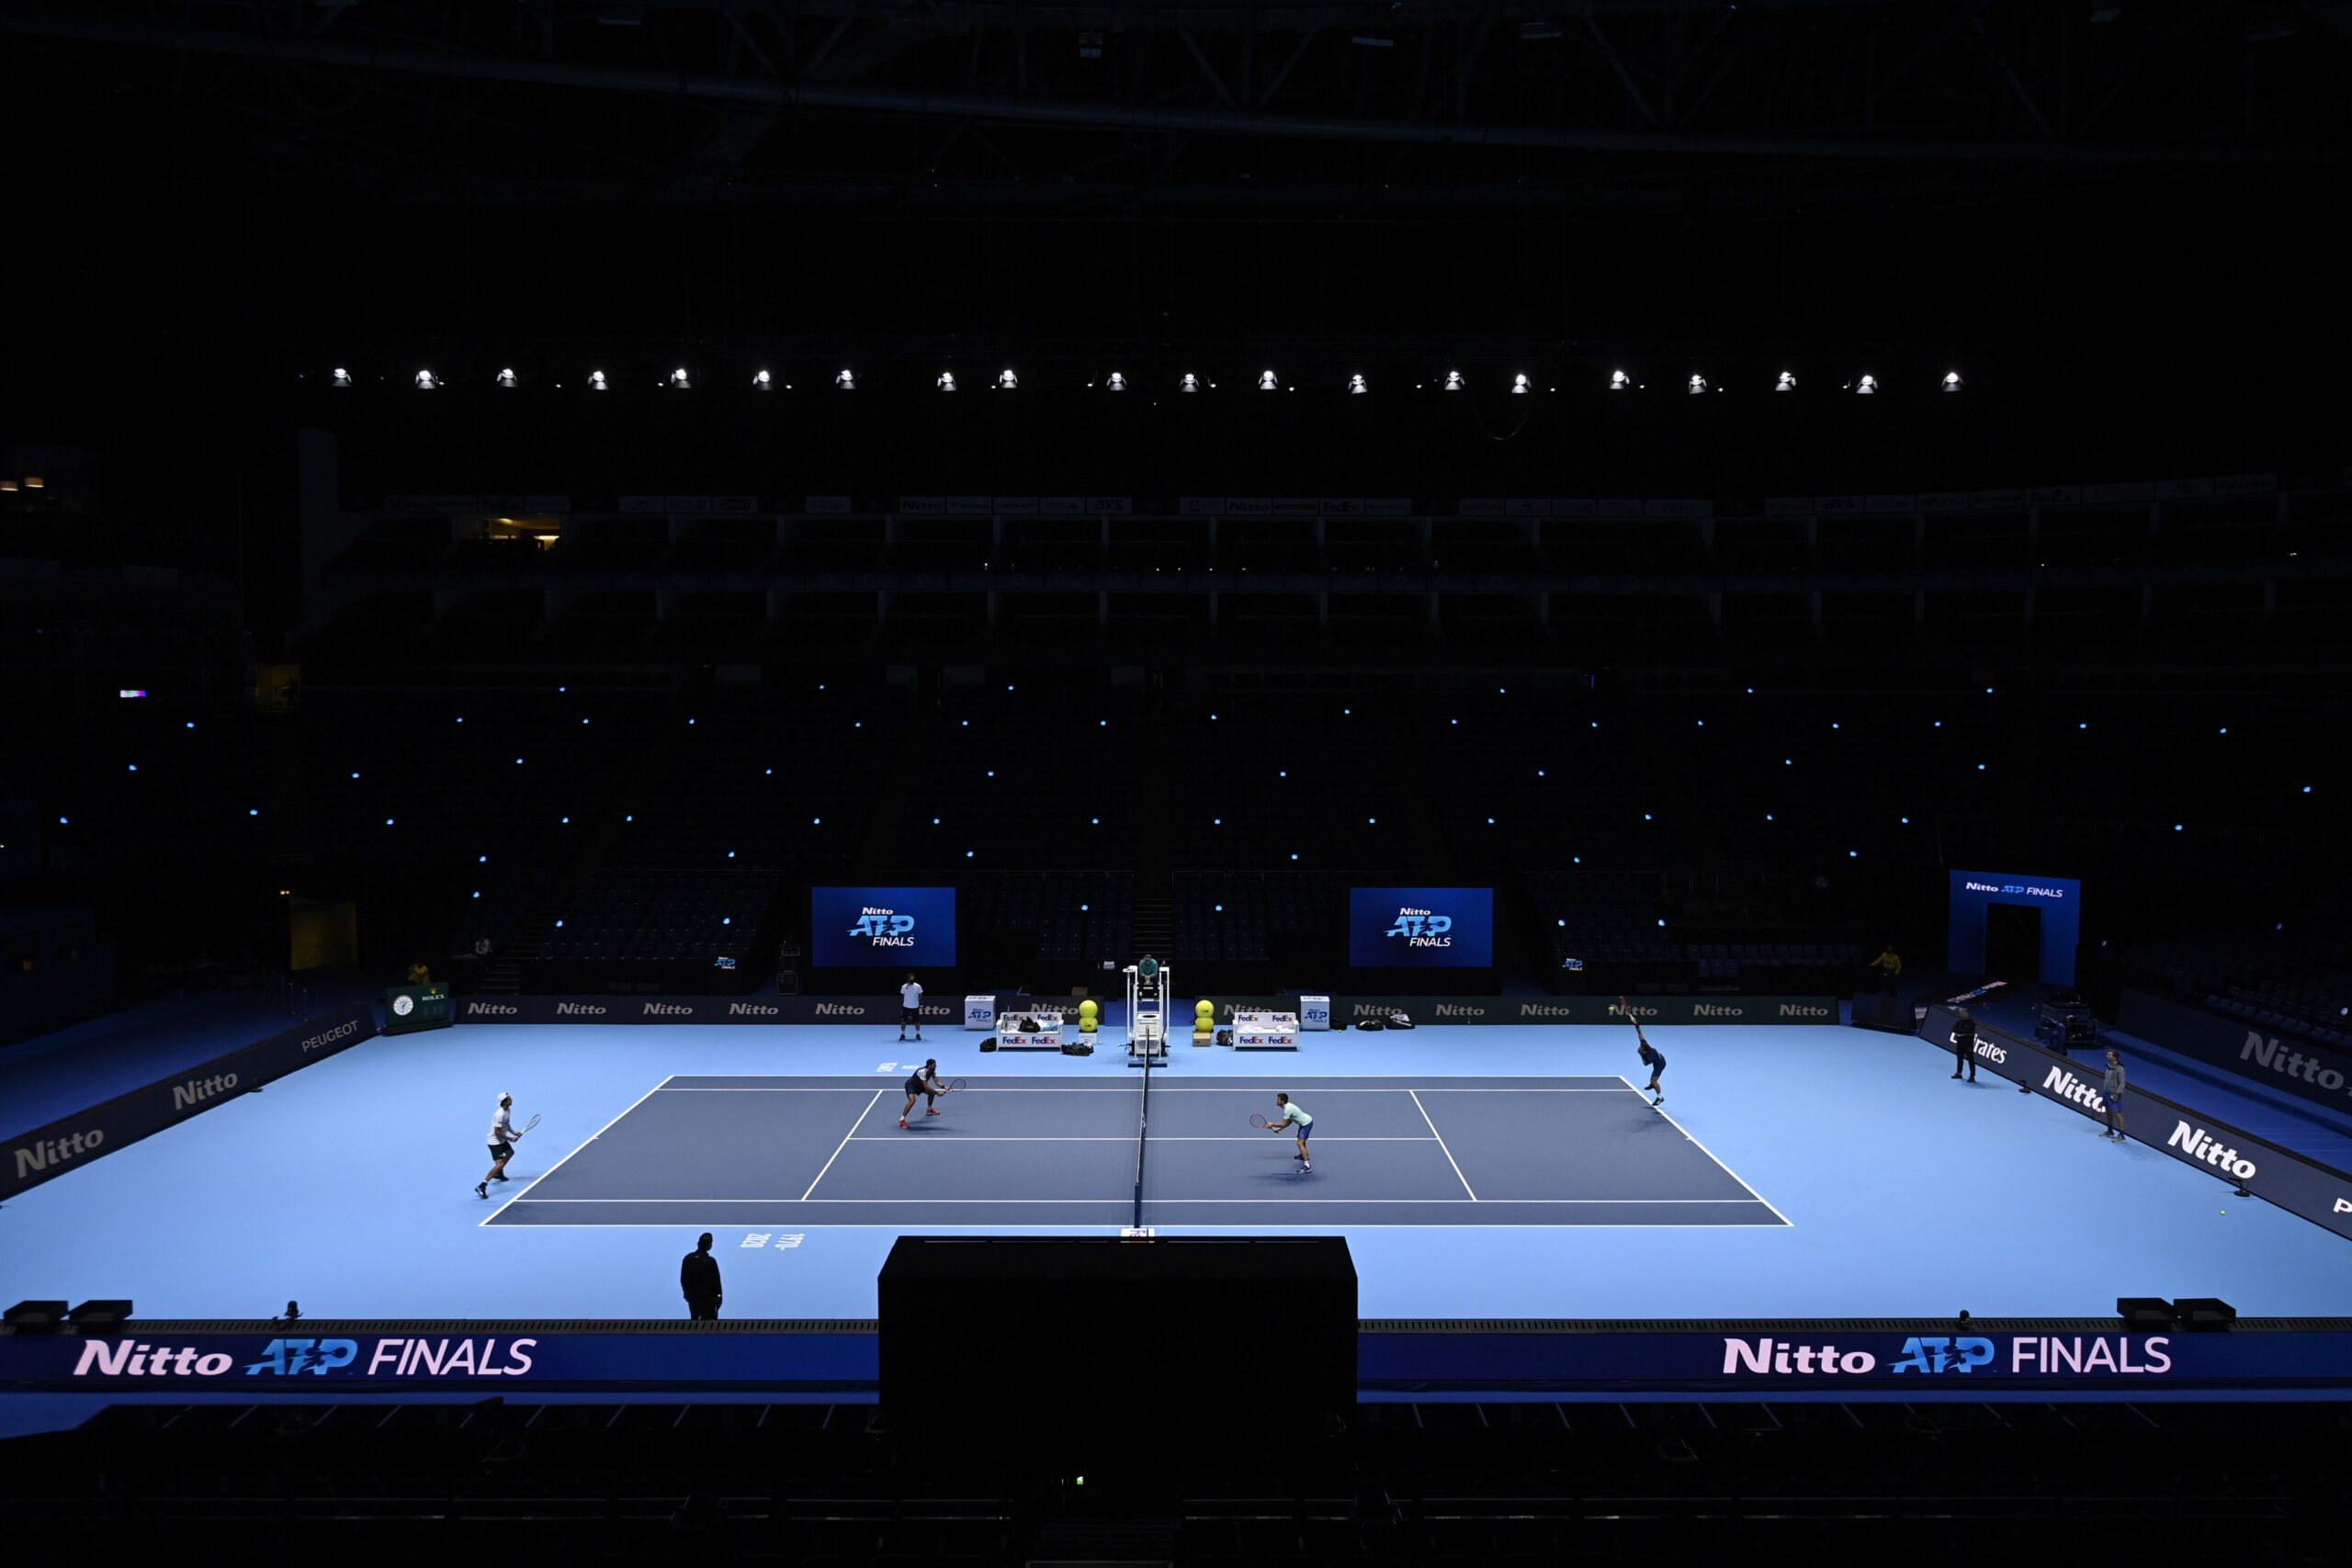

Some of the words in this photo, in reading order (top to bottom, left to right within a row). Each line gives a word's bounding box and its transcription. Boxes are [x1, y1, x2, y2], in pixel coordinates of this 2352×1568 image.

[1965, 882, 1999, 892] Nitto
[2001, 885, 2025, 894] ATP
[2026, 886, 2064, 897] FINALS
[862, 907, 894, 915] Nitto
[1399, 907, 1431, 916] Nitto
[845, 915, 915, 937] ATP
[1383, 915, 1452, 937] ATP
[872, 936, 915, 947] FINALS
[1409, 937, 1452, 947] FINALS
[422, 993, 446, 1002] ROLEX
[467, 1002, 518, 1015] Nitto
[556, 1002, 607, 1015] Nitto
[642, 1002, 694, 1015] Nitto
[729, 1002, 779, 1015] Nitto
[815, 1002, 865, 1015] Nitto
[968, 1010, 992, 1019] ATP
[1352, 1004, 1403, 1016] Nitto
[1435, 1004, 1485, 1016] Nitto
[1520, 1004, 1570, 1016] Nitto
[1693, 1004, 1743, 1016] Nitto
[1779, 1004, 1829, 1016] Nitto
[1037, 1013, 1058, 1021] FedEx
[1238, 1014, 1260, 1022] FedEx
[1272, 1014, 1294, 1022] FedEx
[1304, 1011, 1328, 1020] ATP
[301, 1020, 358, 1052] PEUGEOT
[1002, 1036, 1027, 1044] FedEx
[1031, 1036, 1056, 1044] FedEx
[1239, 1036, 1263, 1044] FedEx
[1268, 1036, 1293, 1044] FedEx
[2240, 1030, 2345, 1089] Nitto
[173, 1072, 239, 1111] Nitto
[2042, 1065, 2107, 1114] Nitto
[14, 1128, 105, 1179] Nitto
[2166, 1119, 2256, 1180] Nitto
[74, 1339, 233, 1376] Nitto
[244, 1338, 358, 1376] ATP
[368, 1338, 537, 1376] FINALS
[1724, 1337, 1876, 1374] Nitto
[1886, 1337, 1996, 1373] ATP
[2012, 1337, 2172, 1373] FINALS
